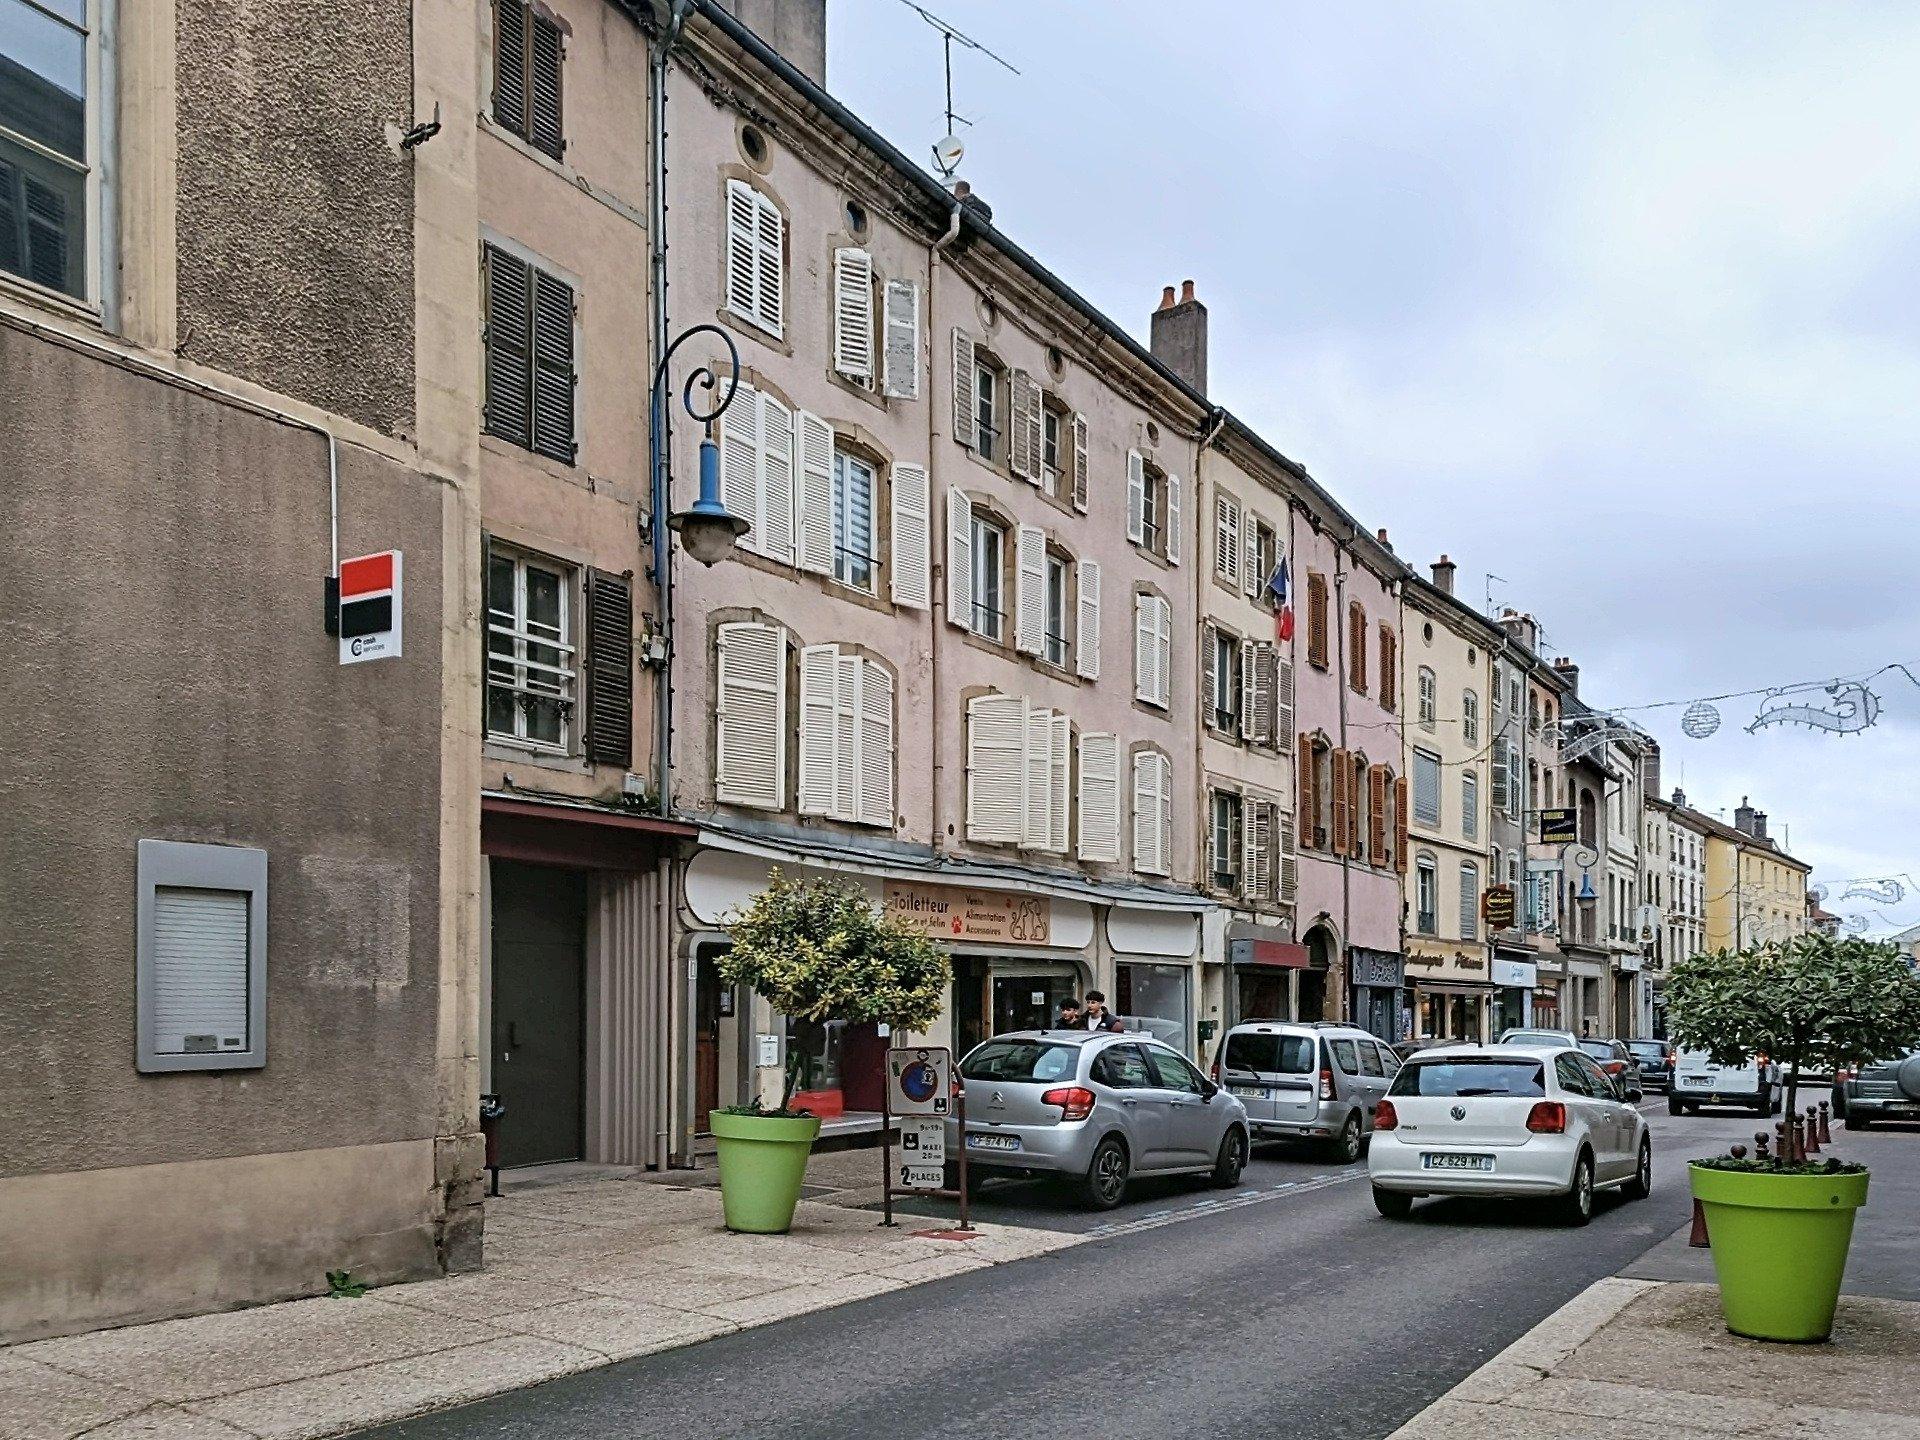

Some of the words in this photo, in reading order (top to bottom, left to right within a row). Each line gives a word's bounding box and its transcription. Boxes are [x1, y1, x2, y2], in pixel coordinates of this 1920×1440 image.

[363, 636, 376, 645] cash
[893, 891, 950, 914] Toiletteur
[900, 1165, 912, 1186] 2
[910, 1172, 942, 1182] PLACES
